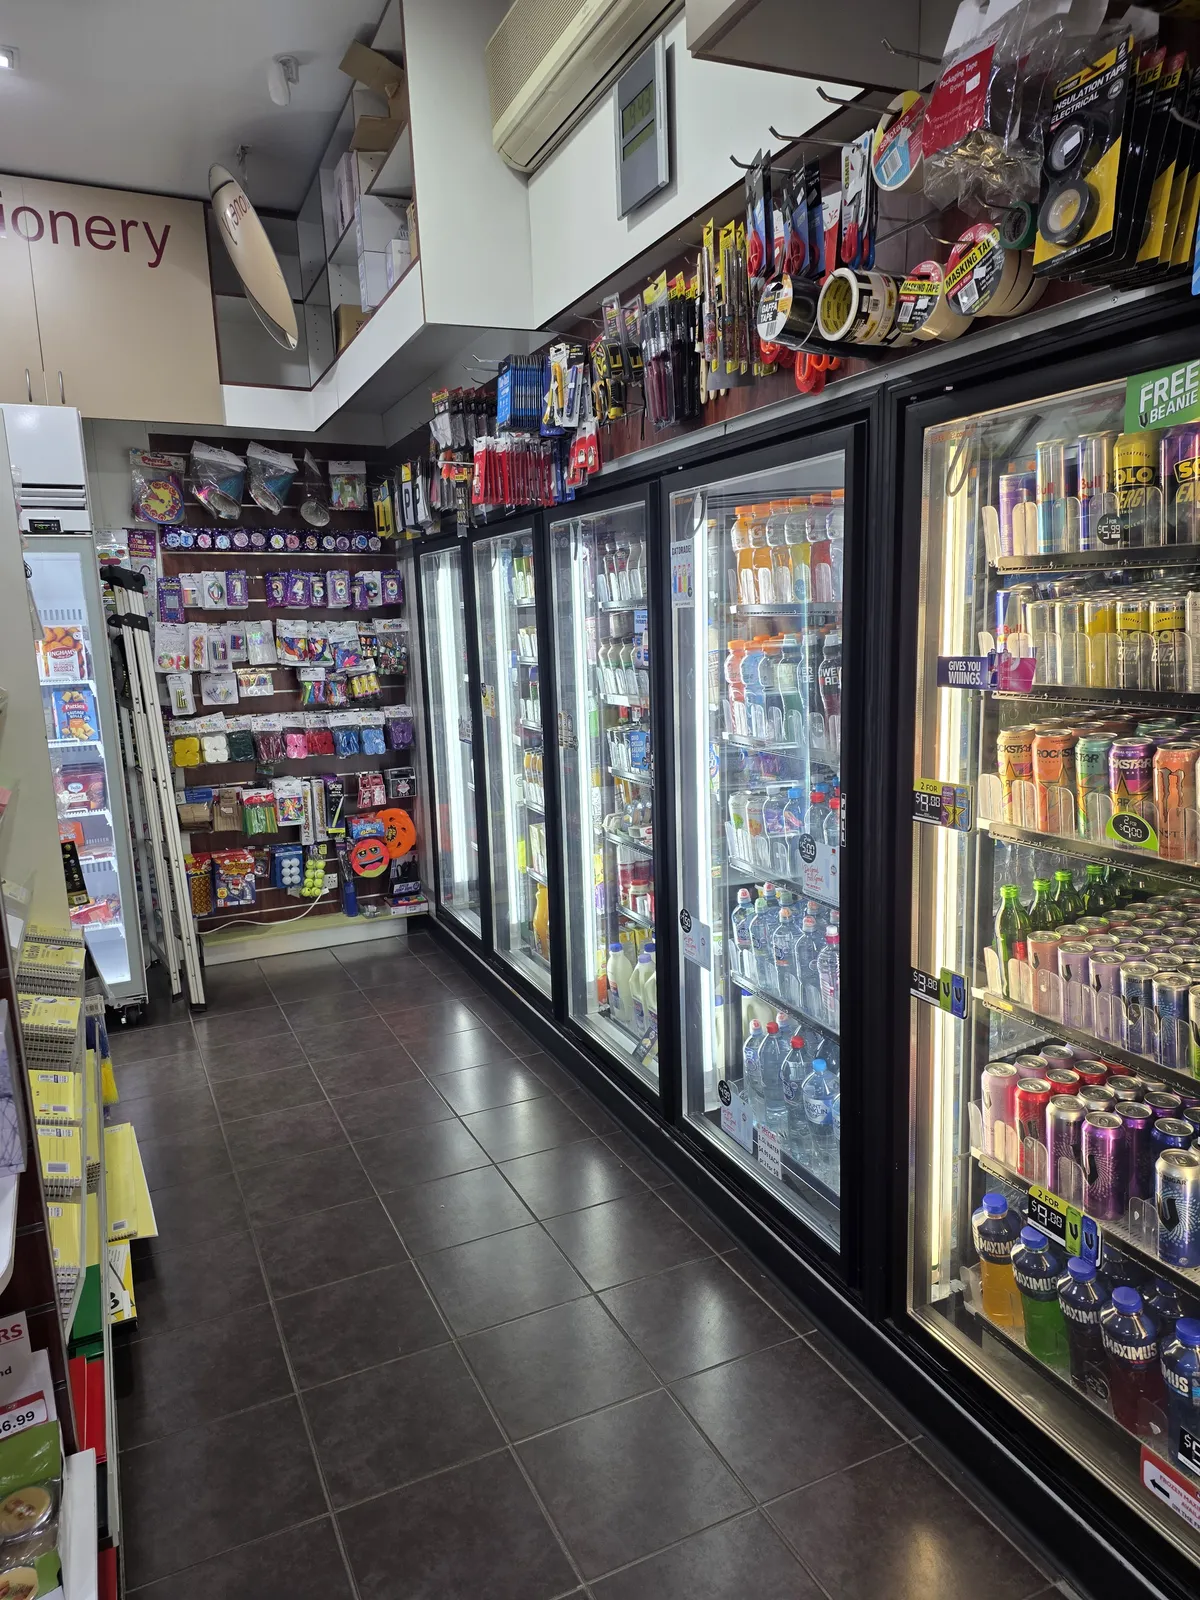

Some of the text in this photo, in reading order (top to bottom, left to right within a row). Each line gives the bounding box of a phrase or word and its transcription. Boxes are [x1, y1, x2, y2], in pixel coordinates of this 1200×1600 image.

[939, 60, 979, 89] Packaging Tape
[1053, 80, 1105, 112] INSULATION
[1104, 60, 1128, 82] TAPE
[1050, 92, 1100, 124] ELECTRICAL
[945, 252, 978, 288] MASKING
[978, 232, 999, 256] TAPE
[925, 284, 940, 293] TAPE
[760, 312, 773, 323] TAPE
[761, 302, 778, 314] GAFFA
[1139, 360, 1200, 414] FREE
[1149, 390, 1198, 424] BEANIE
[1114, 467, 1154, 485] OLO
[1097, 524, 1121, 540] $5.99
[948, 661, 981, 672] GIVES YOU
[920, 782, 925, 790] 2
[1124, 816, 1130, 825] 2
[766, 1141, 780, 1154] WATER
[1037, 1190, 1060, 1209] 2 FOR
[979, 1240, 1015, 1255] MAXIMU
[1060, 1302, 1101, 1325] MAXIMU
[1108, 1342, 1158, 1361] MAXIMUS
[1160, 1474, 1183, 1497] FROZEN
[1172, 1502, 1181, 1514] ON
[1181, 1510, 1193, 1524] THE
